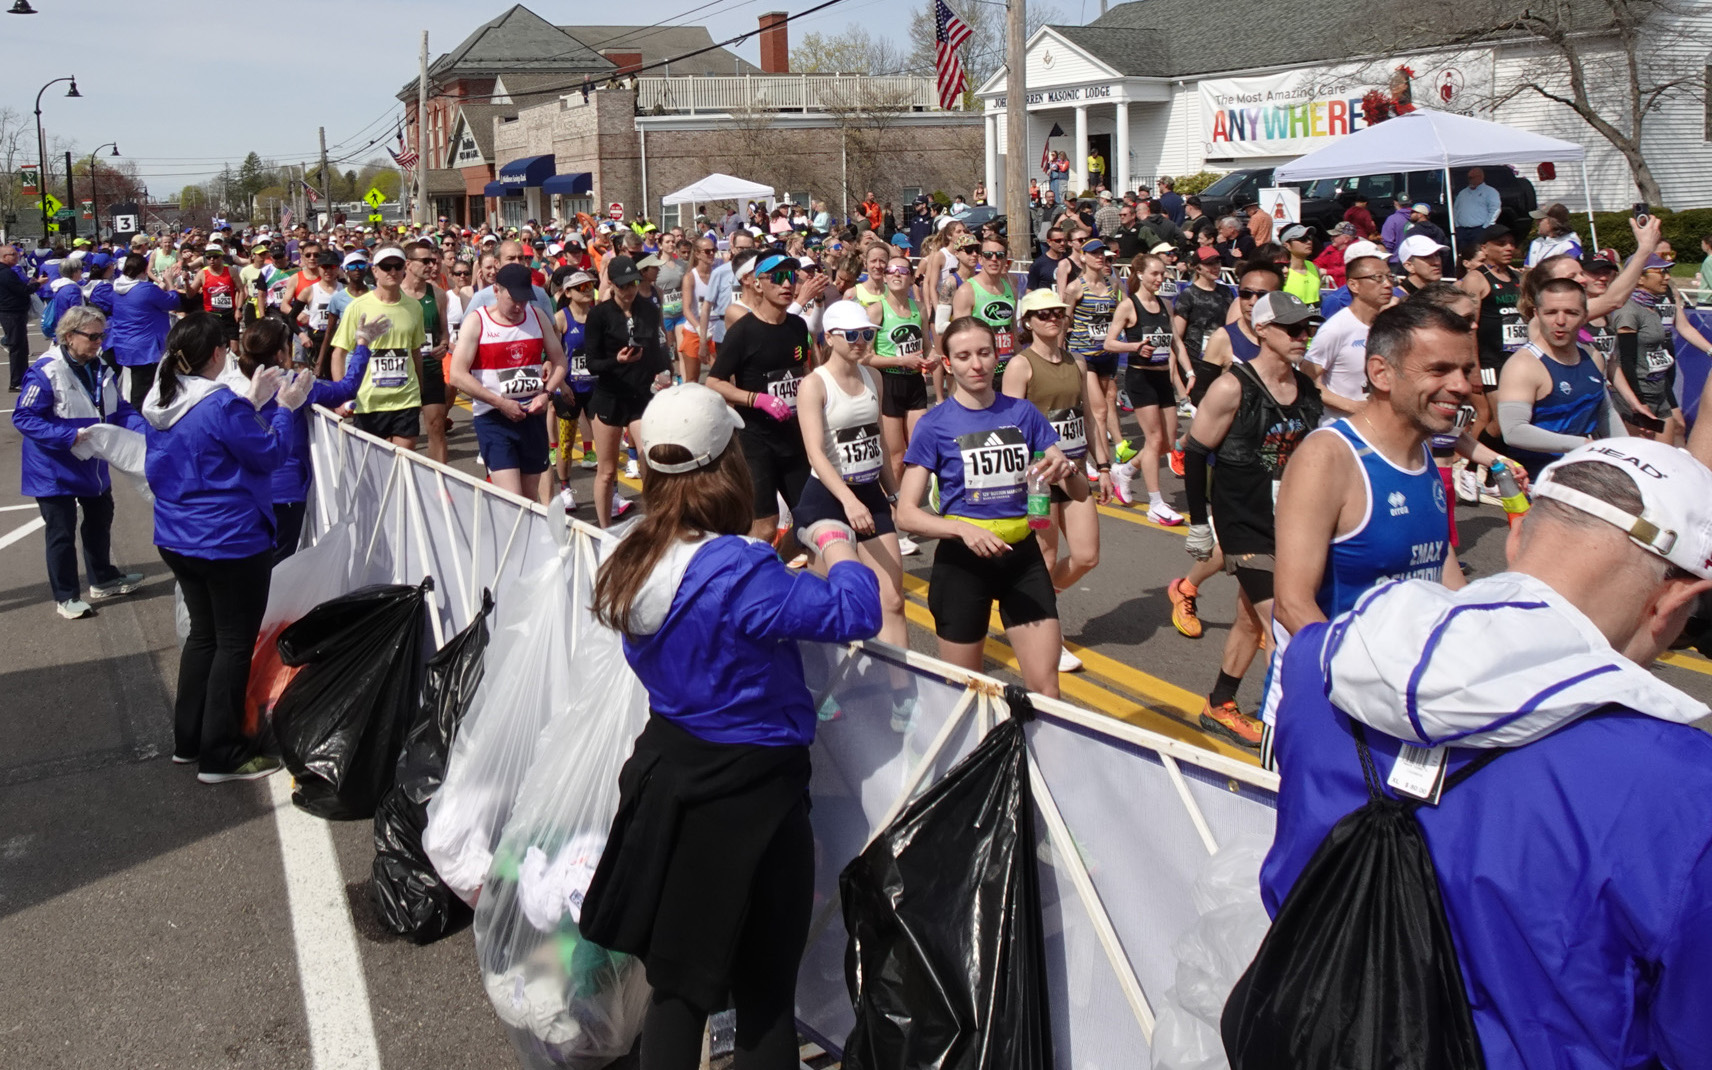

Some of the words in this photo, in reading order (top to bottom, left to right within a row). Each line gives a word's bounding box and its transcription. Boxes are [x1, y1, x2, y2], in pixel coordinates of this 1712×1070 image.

[993, 98, 1007, 108] JOH
[1027, 94, 1044, 104] RREN
[1048, 89, 1079, 102] MASONIC
[1085, 86, 1111, 98] LODGE
[1216, 95, 1233, 105] The
[1237, 92, 1262, 104] Most
[1266, 88, 1315, 101] Amazing
[1318, 84, 1346, 95] Care
[1212, 98, 1364, 143] ANYWHERE
[120, 217, 131, 230] 3
[1096, 303, 1109, 312] JEN
[504, 379, 539, 394] 12752
[969, 447, 1025, 475] 15705
[1586, 447, 1663, 478] HEAD
